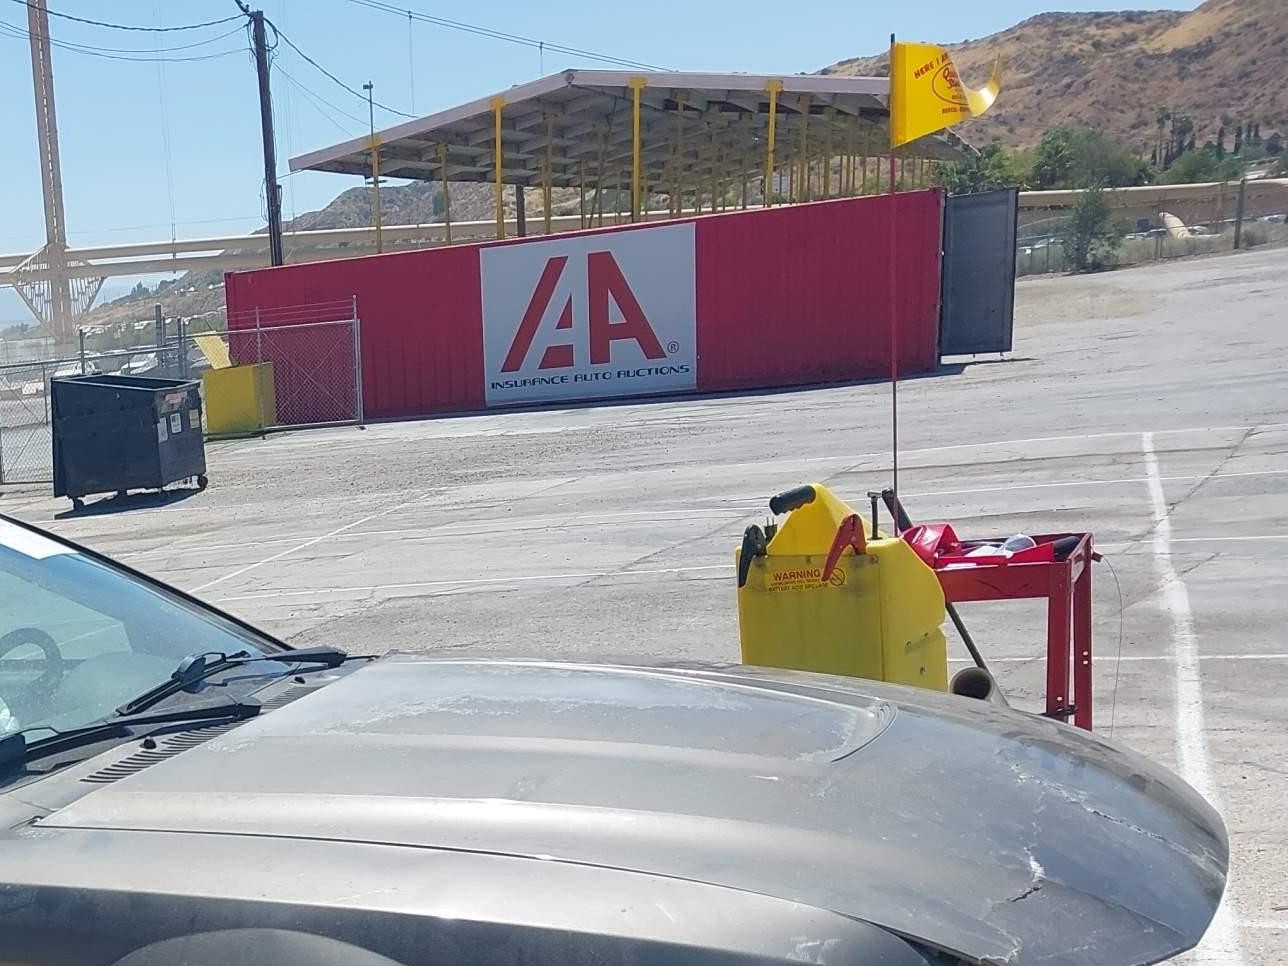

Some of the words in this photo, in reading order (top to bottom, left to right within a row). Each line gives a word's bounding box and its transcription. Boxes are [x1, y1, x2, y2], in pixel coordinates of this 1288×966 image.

[914, 61, 934, 79] HERE
[491, 374, 569, 390] INSURANCE
[574, 371, 613, 382] AUTO
[617, 364, 690, 378] AUCTIONS
[773, 569, 821, 581] WARNING
